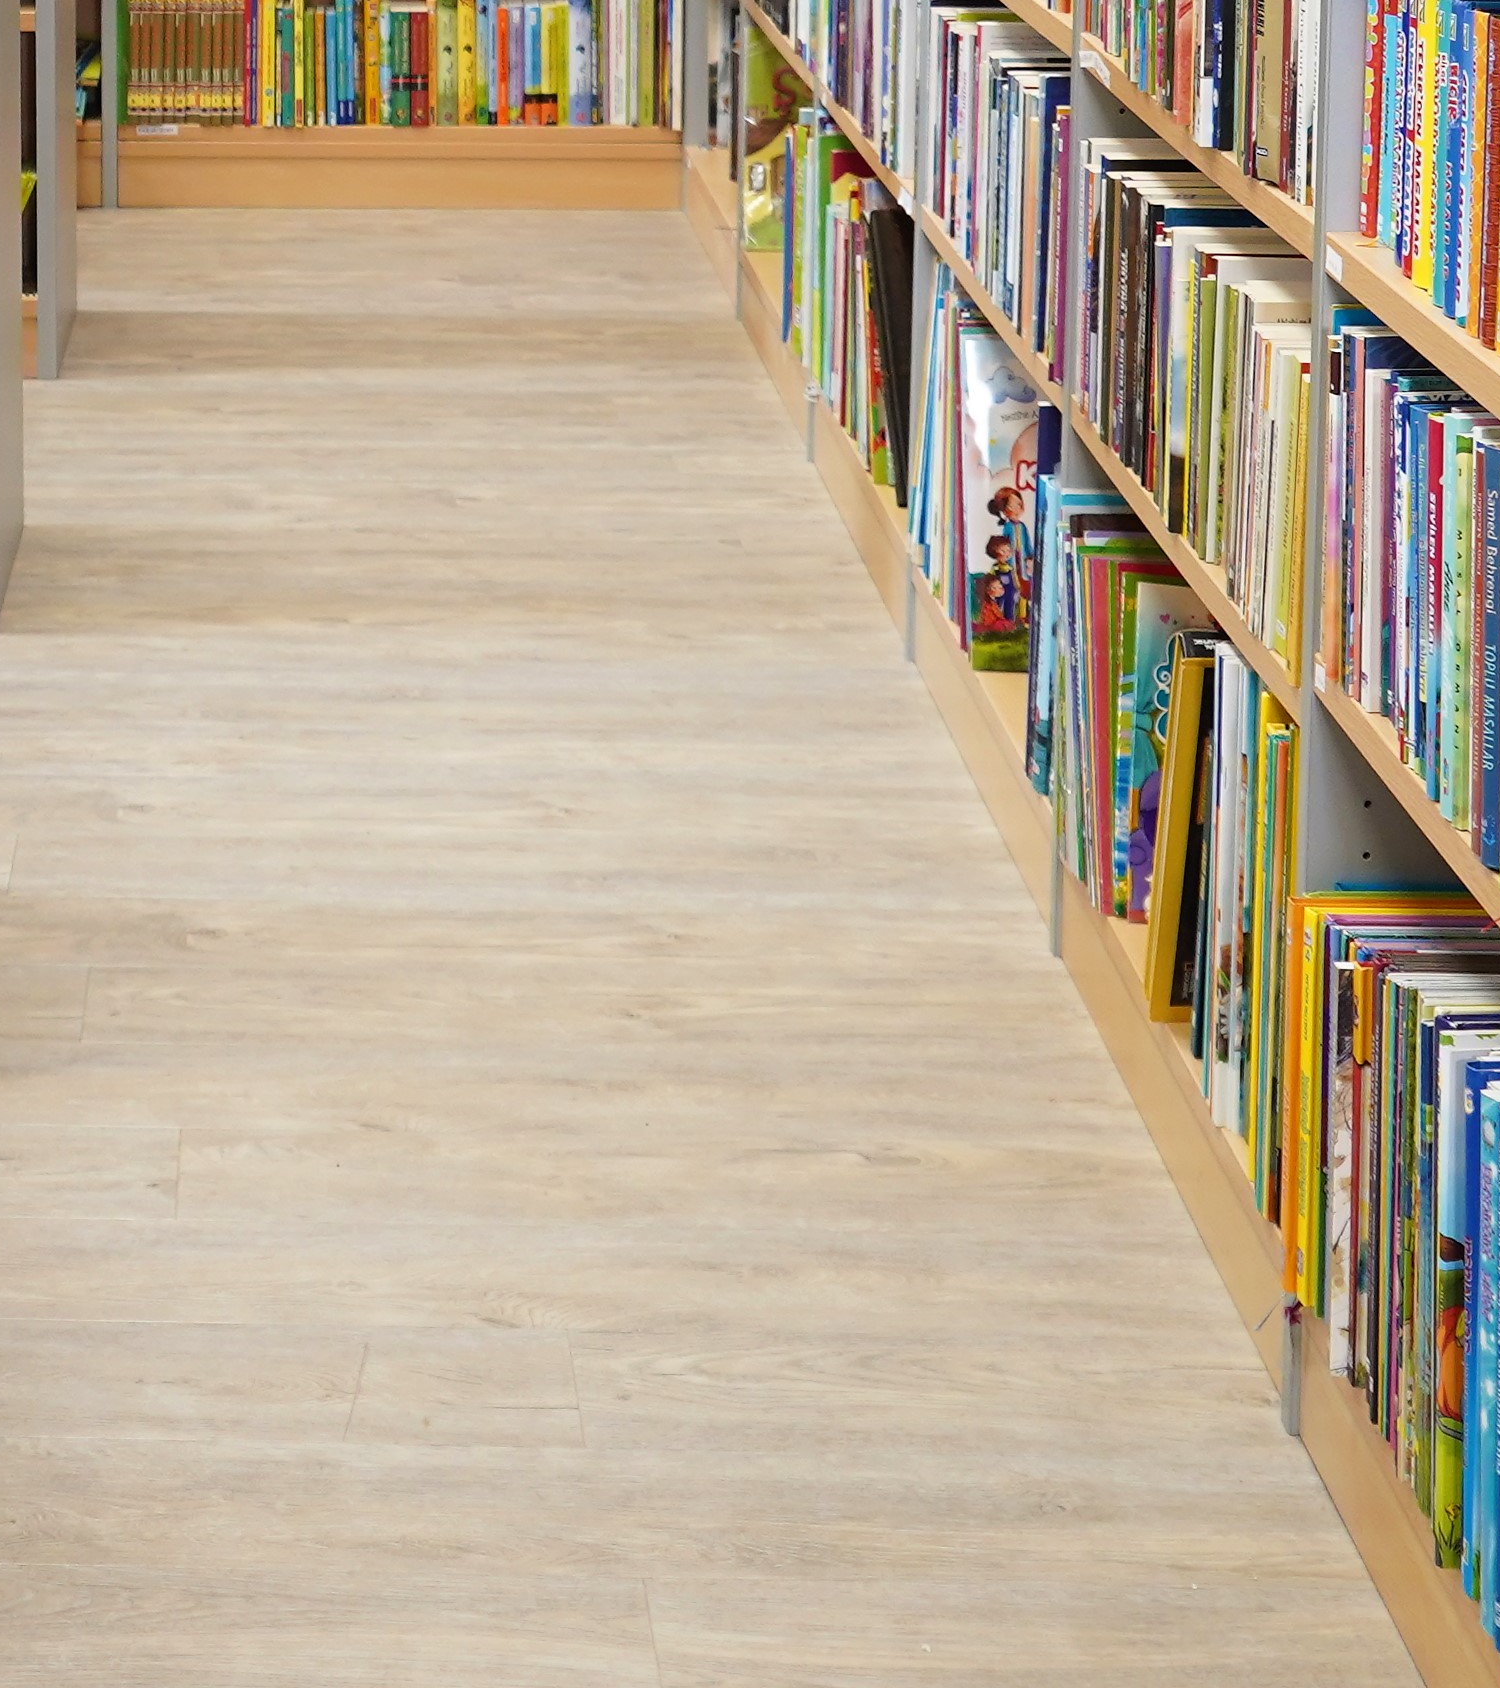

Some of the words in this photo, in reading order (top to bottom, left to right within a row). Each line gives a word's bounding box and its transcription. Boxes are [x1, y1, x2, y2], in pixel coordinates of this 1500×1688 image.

[1485, 488, 1498, 539] Samed
[1483, 544, 1498, 614] Behrengi
[1483, 643, 1497, 690] TOPLU
[1482, 694, 1496, 770] MASALLAR
